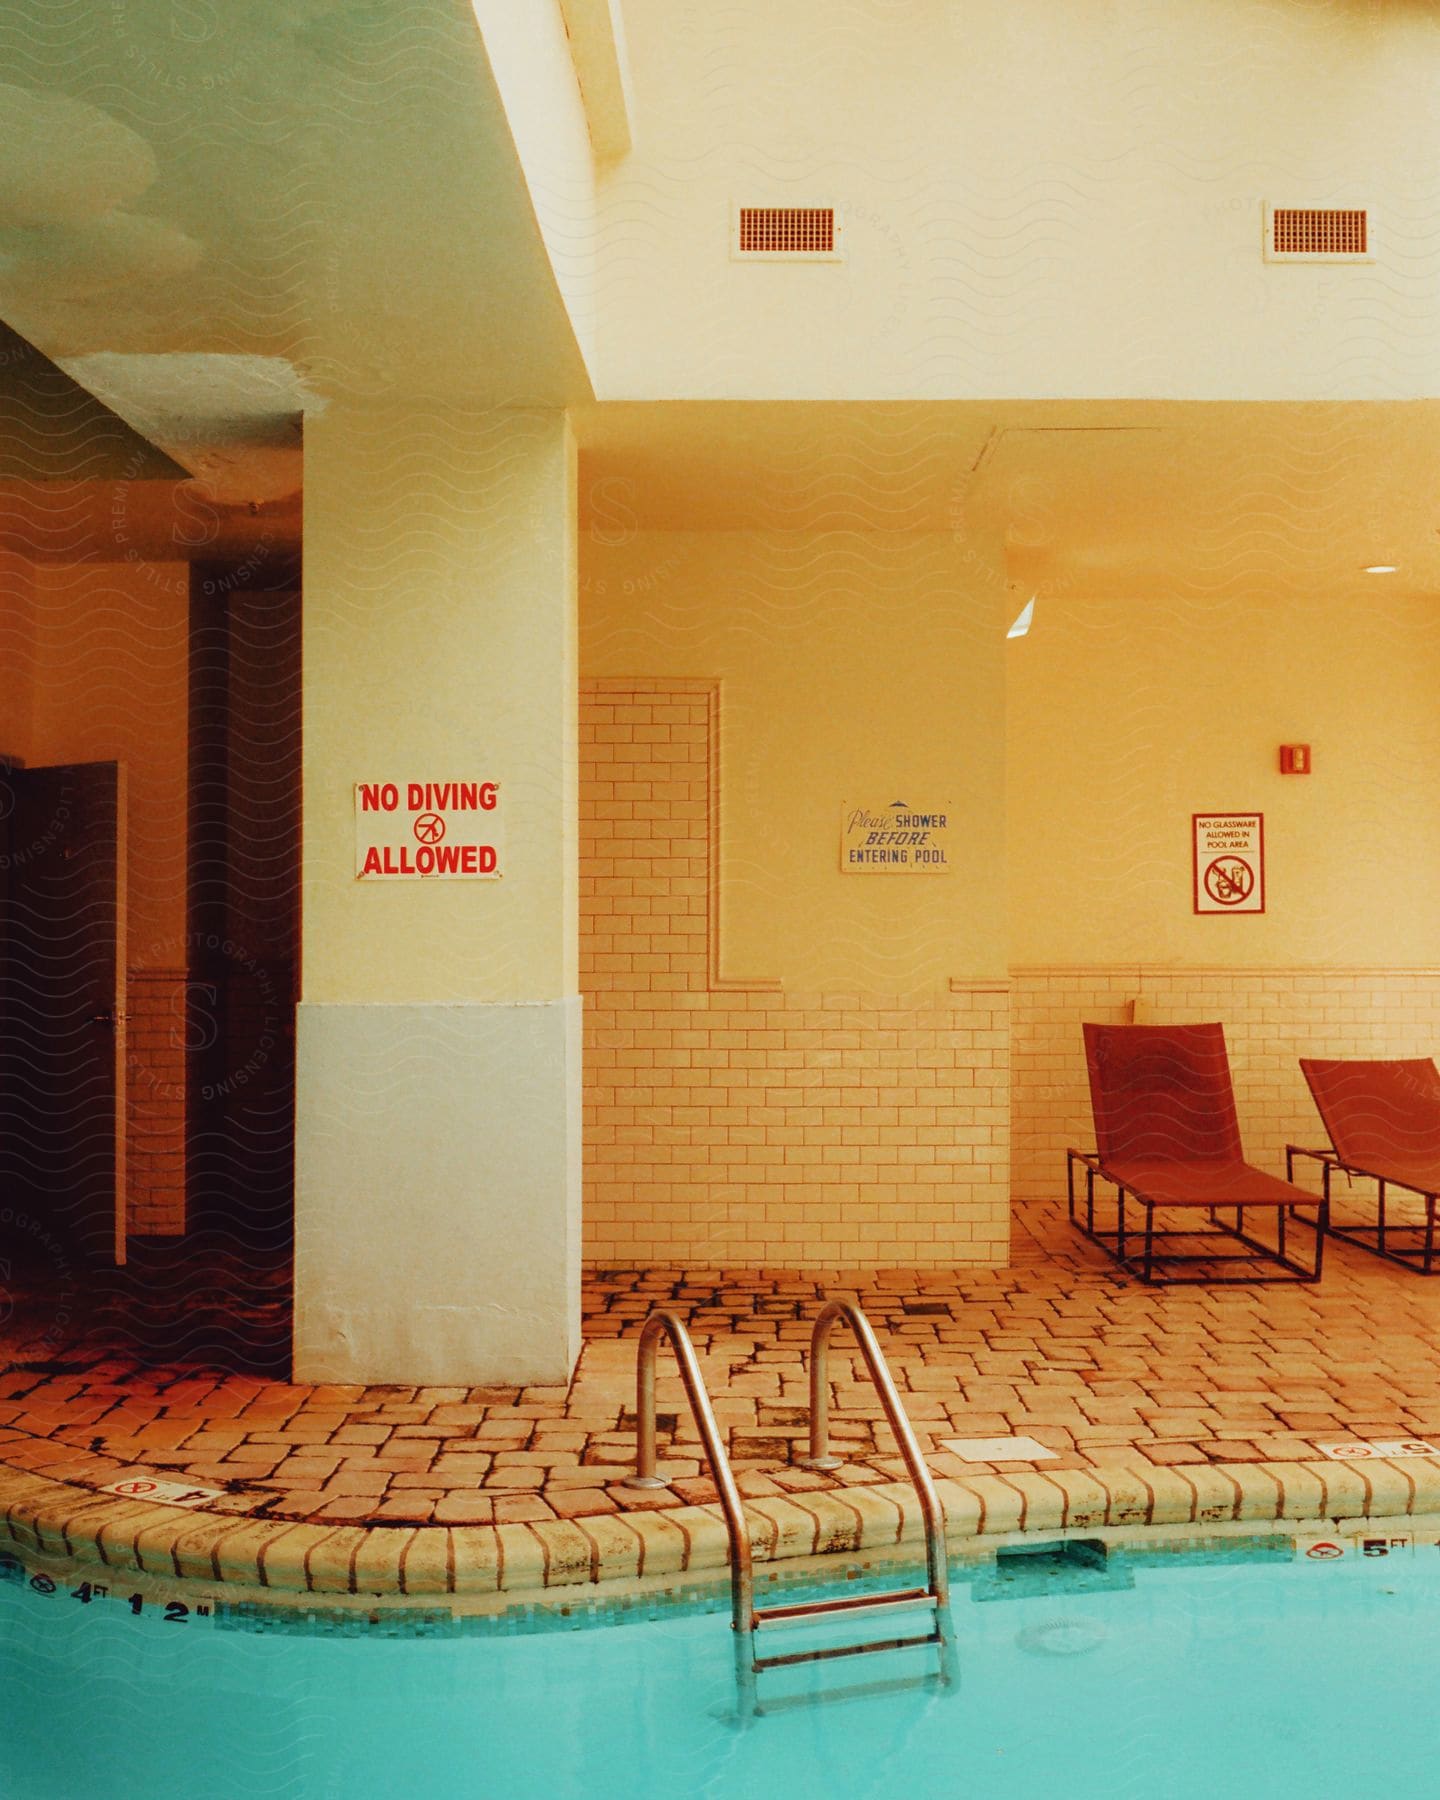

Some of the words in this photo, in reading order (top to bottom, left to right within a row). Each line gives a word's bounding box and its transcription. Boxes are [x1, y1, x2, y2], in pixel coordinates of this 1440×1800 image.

[361, 783, 399, 812] NO
[407, 782, 497, 811] DIVING
[848, 808, 891, 834] Please
[896, 814, 947, 828] SHOWER
[1198, 821, 1211, 829] NO
[1213, 820, 1256, 829] GLASSWARE
[865, 831, 931, 846] BEFORE
[1206, 830, 1240, 839] ALLOWED
[1242, 830, 1250, 838] IN
[1207, 841, 1228, 849] POOL
[1229, 840, 1249, 849] AREA
[363, 845, 497, 874] ALLOWED
[849, 849, 908, 864] ENTERING
[915, 849, 948, 864] POOL
